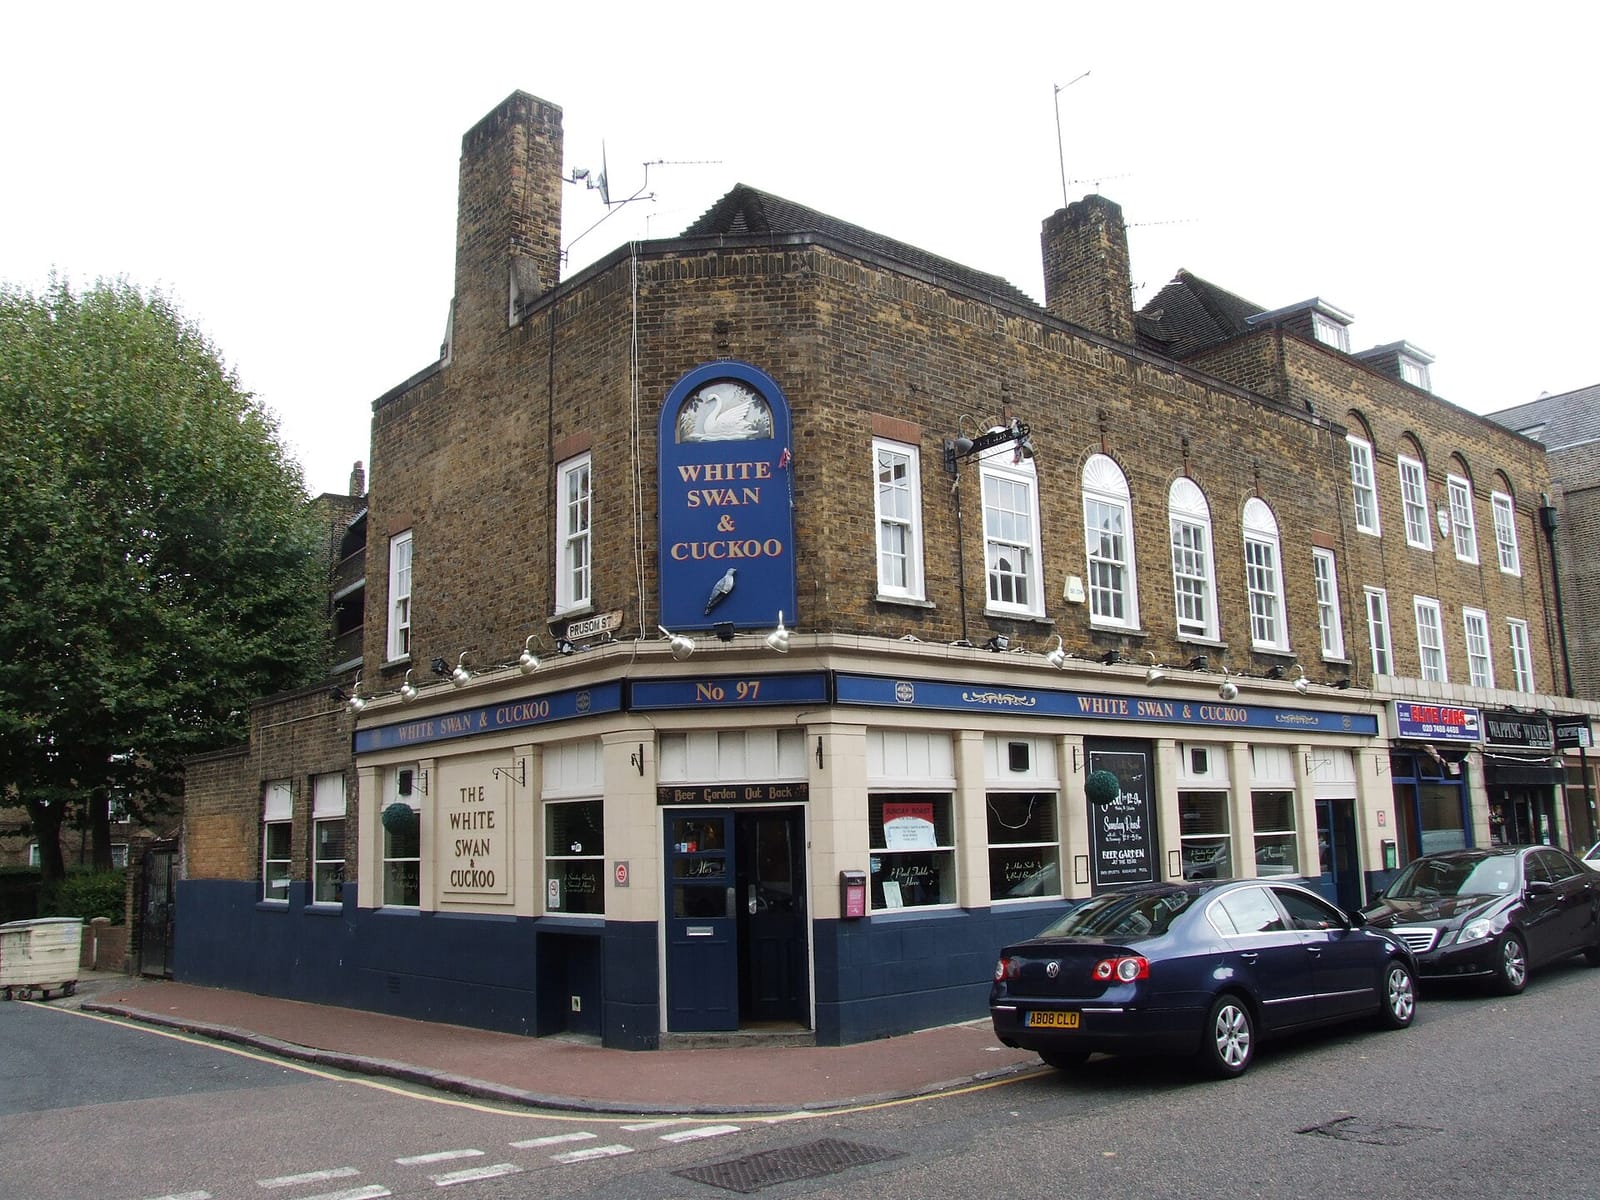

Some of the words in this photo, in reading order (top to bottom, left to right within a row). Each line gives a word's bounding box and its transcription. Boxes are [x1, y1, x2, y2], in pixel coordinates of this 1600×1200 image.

[677, 462, 771, 483] WHITE
[687, 487, 761, 508] SWAN
[716, 514, 736, 532] &
[671, 538, 782, 560] CUCKOO
[695, 682, 725, 701] No
[736, 681, 760, 700] 97
[1077, 697, 1128, 716] WHITE
[1138, 703, 1174, 718] SWAN
[1182, 705, 1192, 719] &
[1200, 705, 1248, 722] CUCKOO
[1410, 704, 1440, 724] ELITE
[1441, 708, 1466, 726] CARS
[398, 721, 434, 741] WHITE
[440, 714, 471, 735] SWAN
[479, 711, 488, 728] &
[495, 700, 549, 724] CUCKOO
[1487, 720, 1522, 739] WAPPING
[1522, 723, 1548, 740] WINES
[1556, 726, 1579, 738] OPE
[460, 786, 485, 804] THE
[674, 789, 696, 801] Beer
[704, 788, 736, 802] Garden
[745, 787, 763, 800] Out
[769, 786, 792, 799] Back
[450, 811, 495, 830] WHITE
[455, 839, 490, 857] SWAN
[469, 858, 475, 869] &
[450, 869, 495, 888] CUCKOO
[1030, 1011, 1054, 1025] AB08
[1056, 1013, 1077, 1026] CLO
